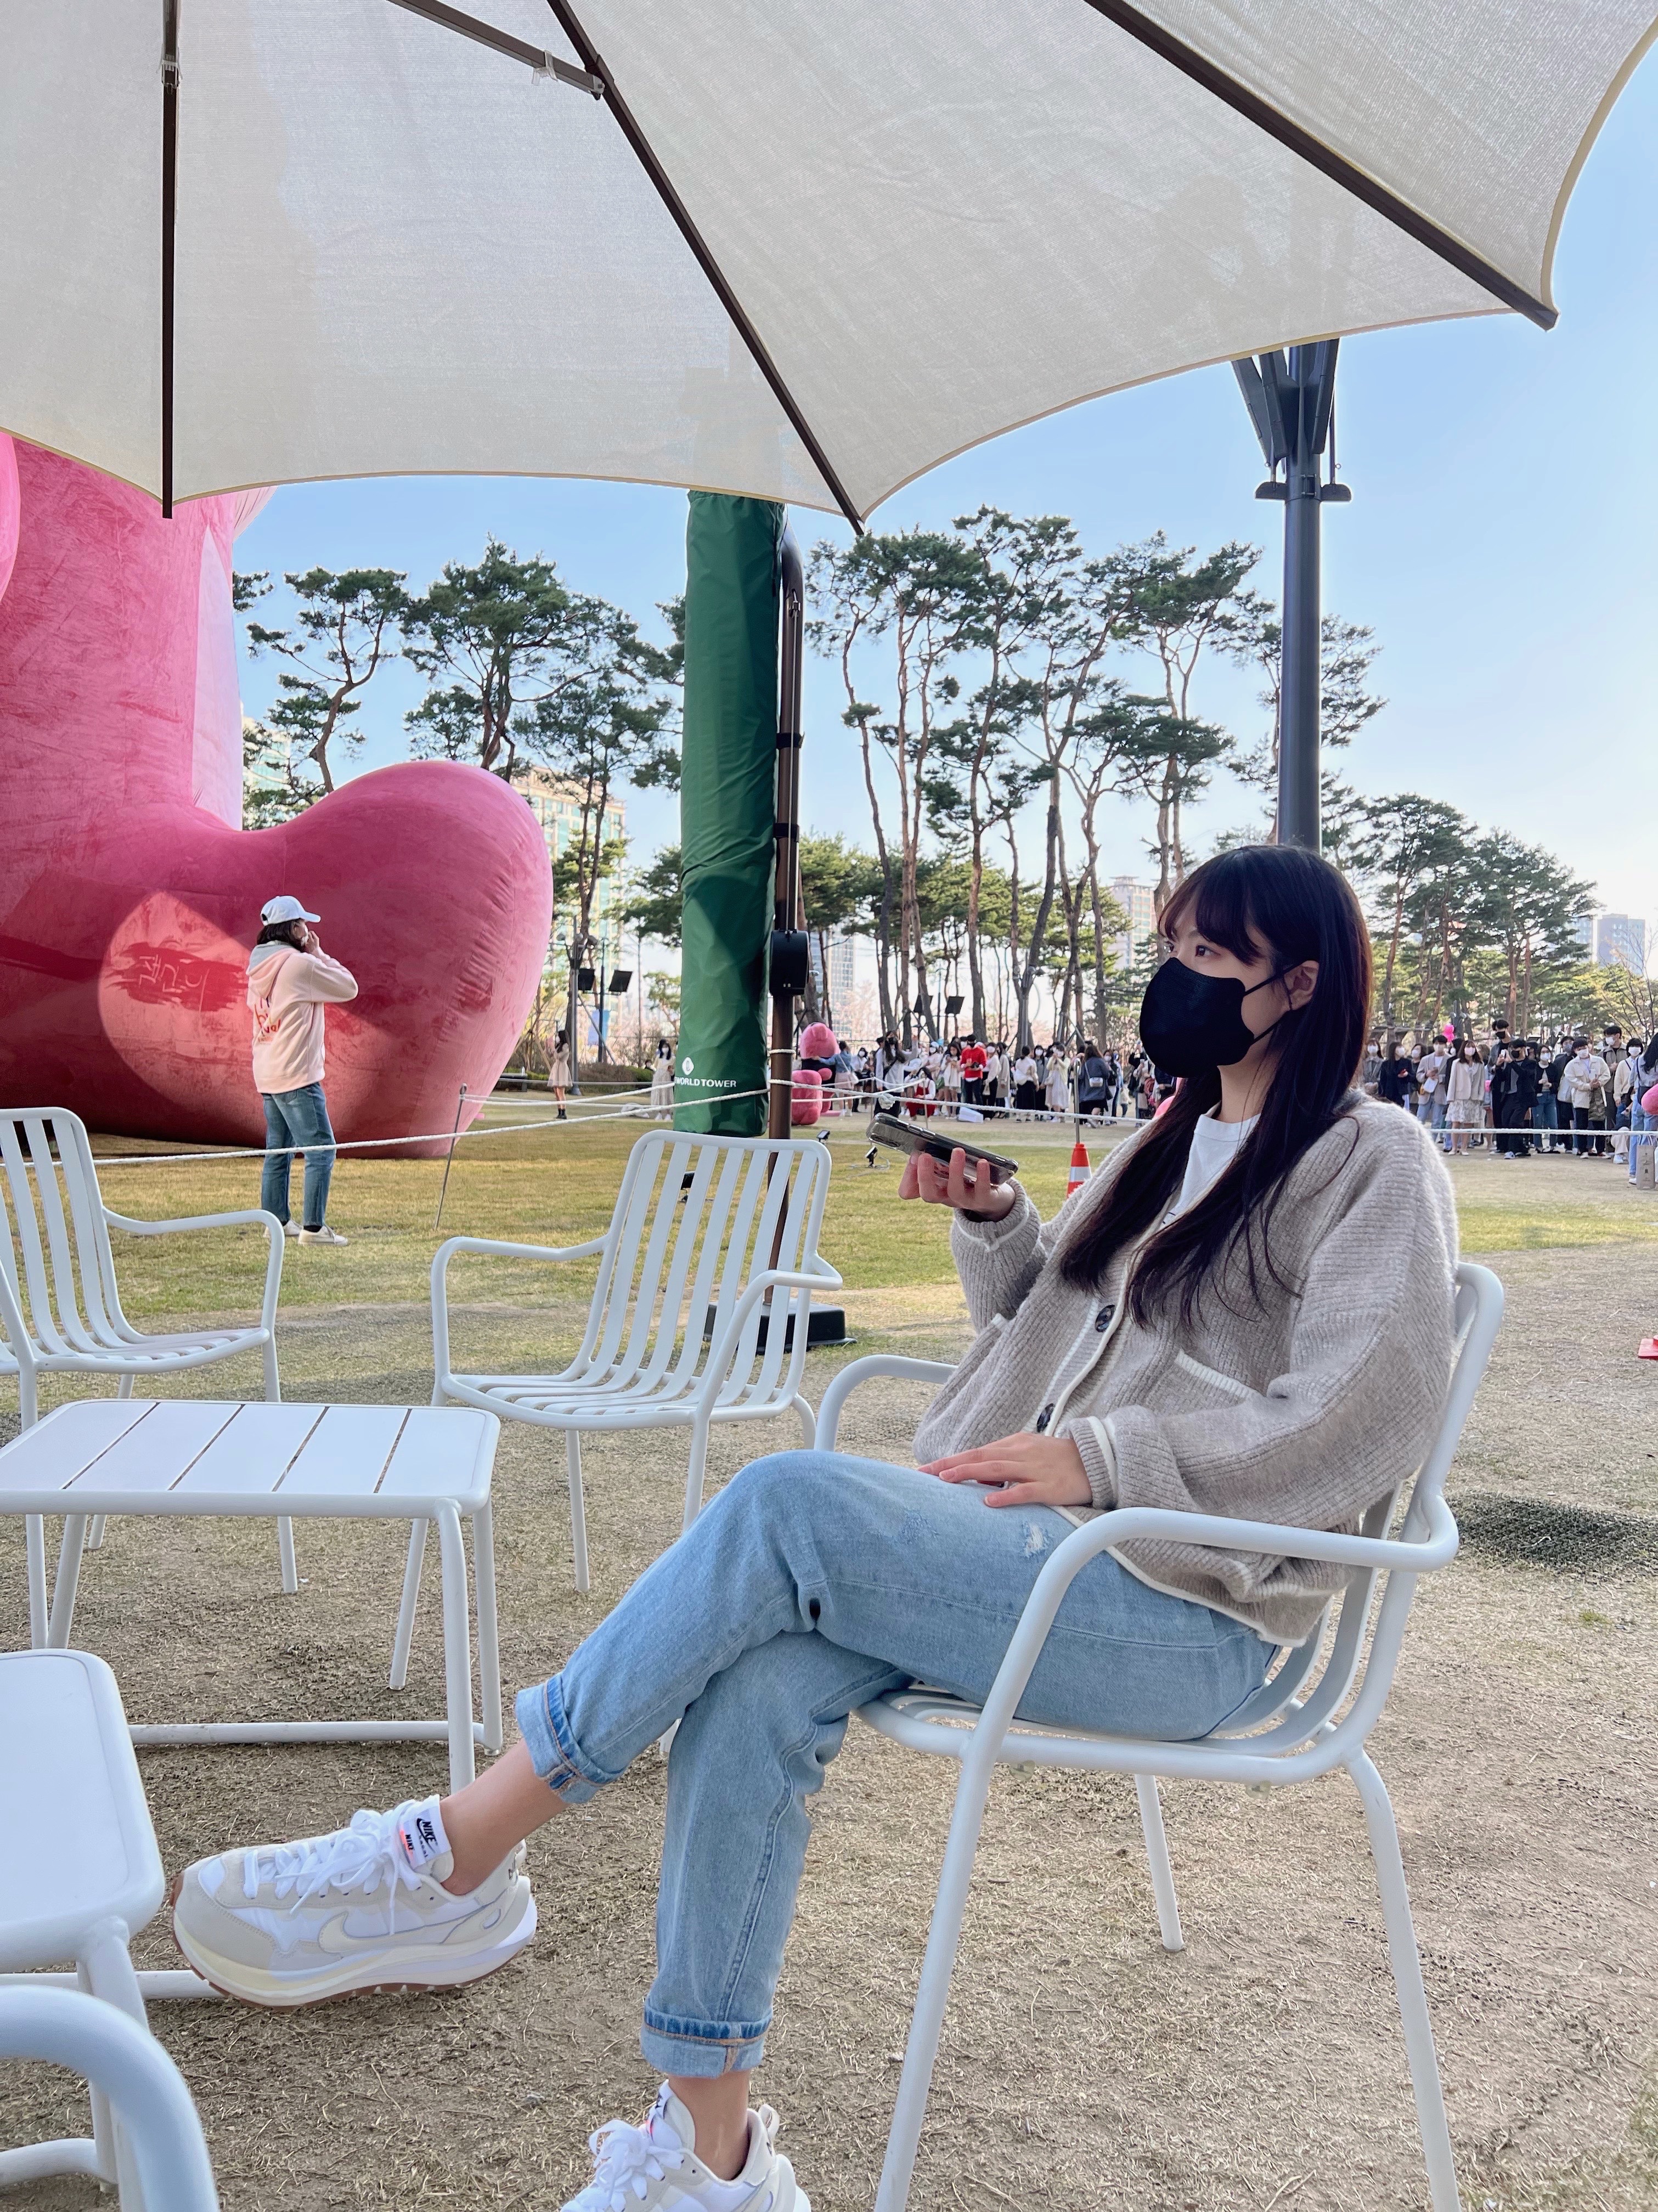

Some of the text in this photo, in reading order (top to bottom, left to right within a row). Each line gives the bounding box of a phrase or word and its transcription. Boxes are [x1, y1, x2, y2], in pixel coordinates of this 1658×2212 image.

[676, 1077, 701, 1086] WORLD
[701, 1079, 737, 1087] TOWER
[422, 1821, 437, 1842] NIKE
